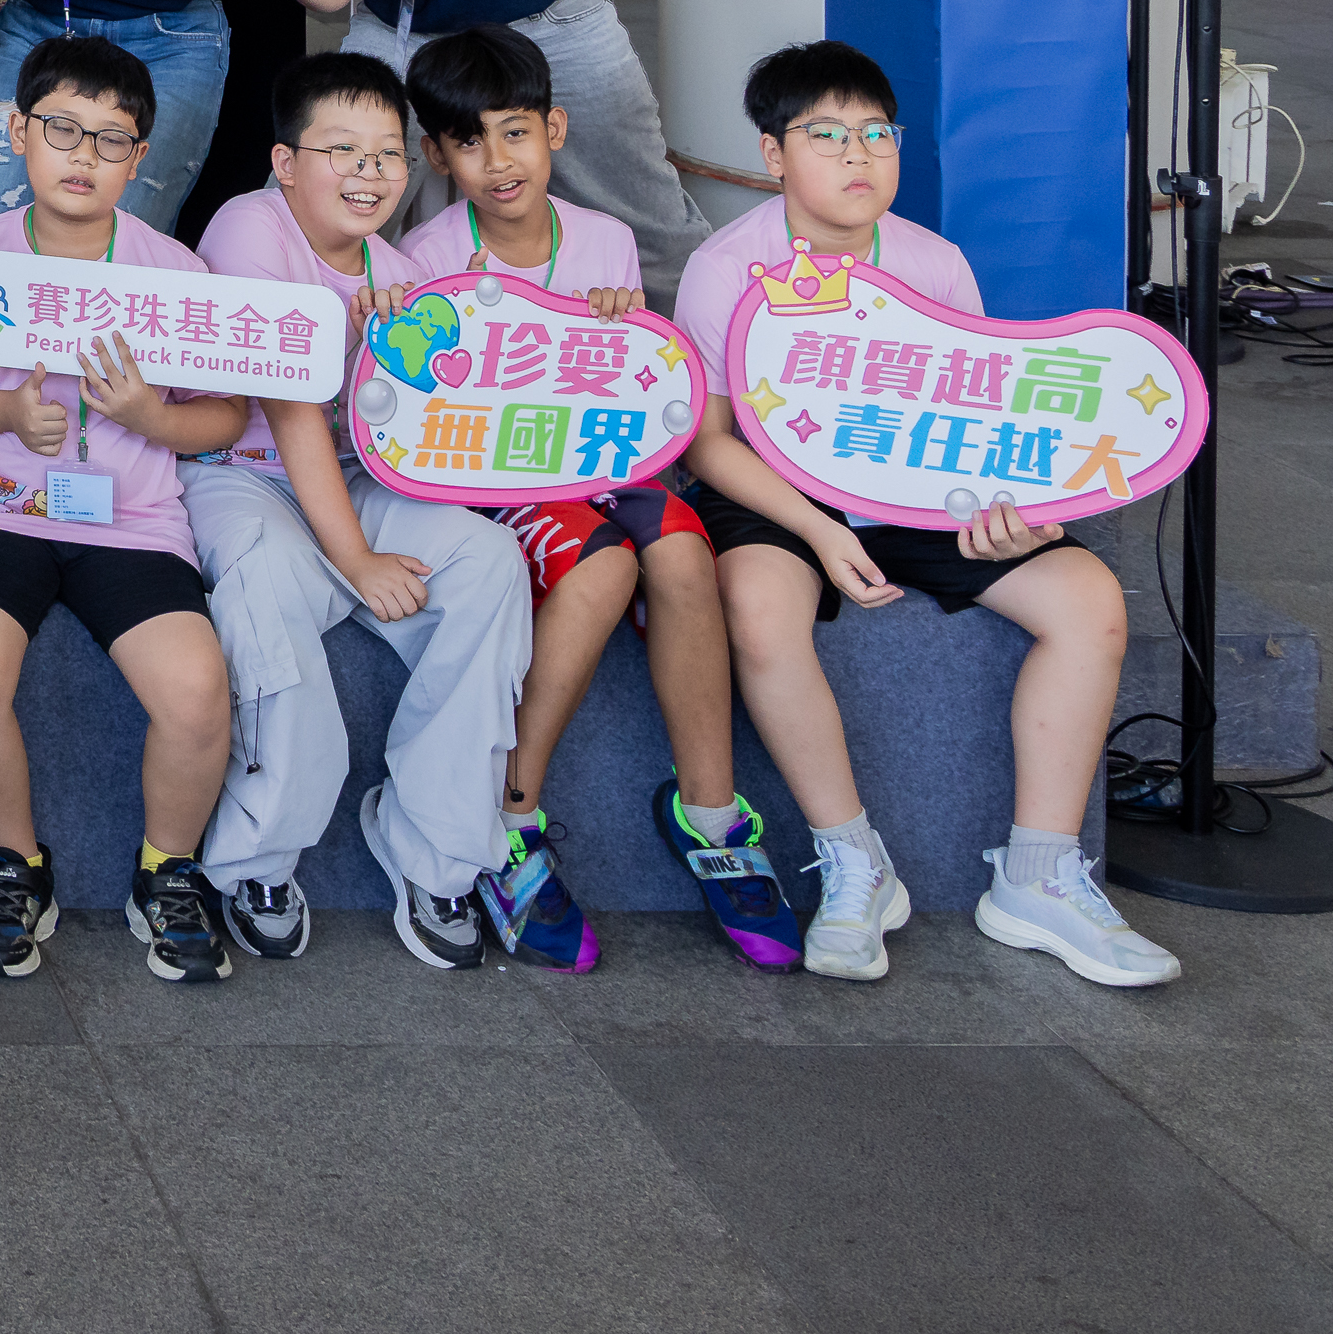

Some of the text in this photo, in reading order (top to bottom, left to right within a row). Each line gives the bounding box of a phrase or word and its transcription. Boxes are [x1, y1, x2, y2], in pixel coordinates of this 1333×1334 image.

[25, 332, 81, 354] Pearl
[133, 346, 172, 365] uck
[180, 350, 311, 381] Foundation
[27, 282, 319, 356] 賽珍珠基金會
[473, 322, 630, 397] 珍愛
[779, 328, 1112, 424] 顏質越高
[413, 398, 647, 478] 無國界
[832, 403, 1141, 501] 責任越大
[699, 855, 742, 875] NIKE
